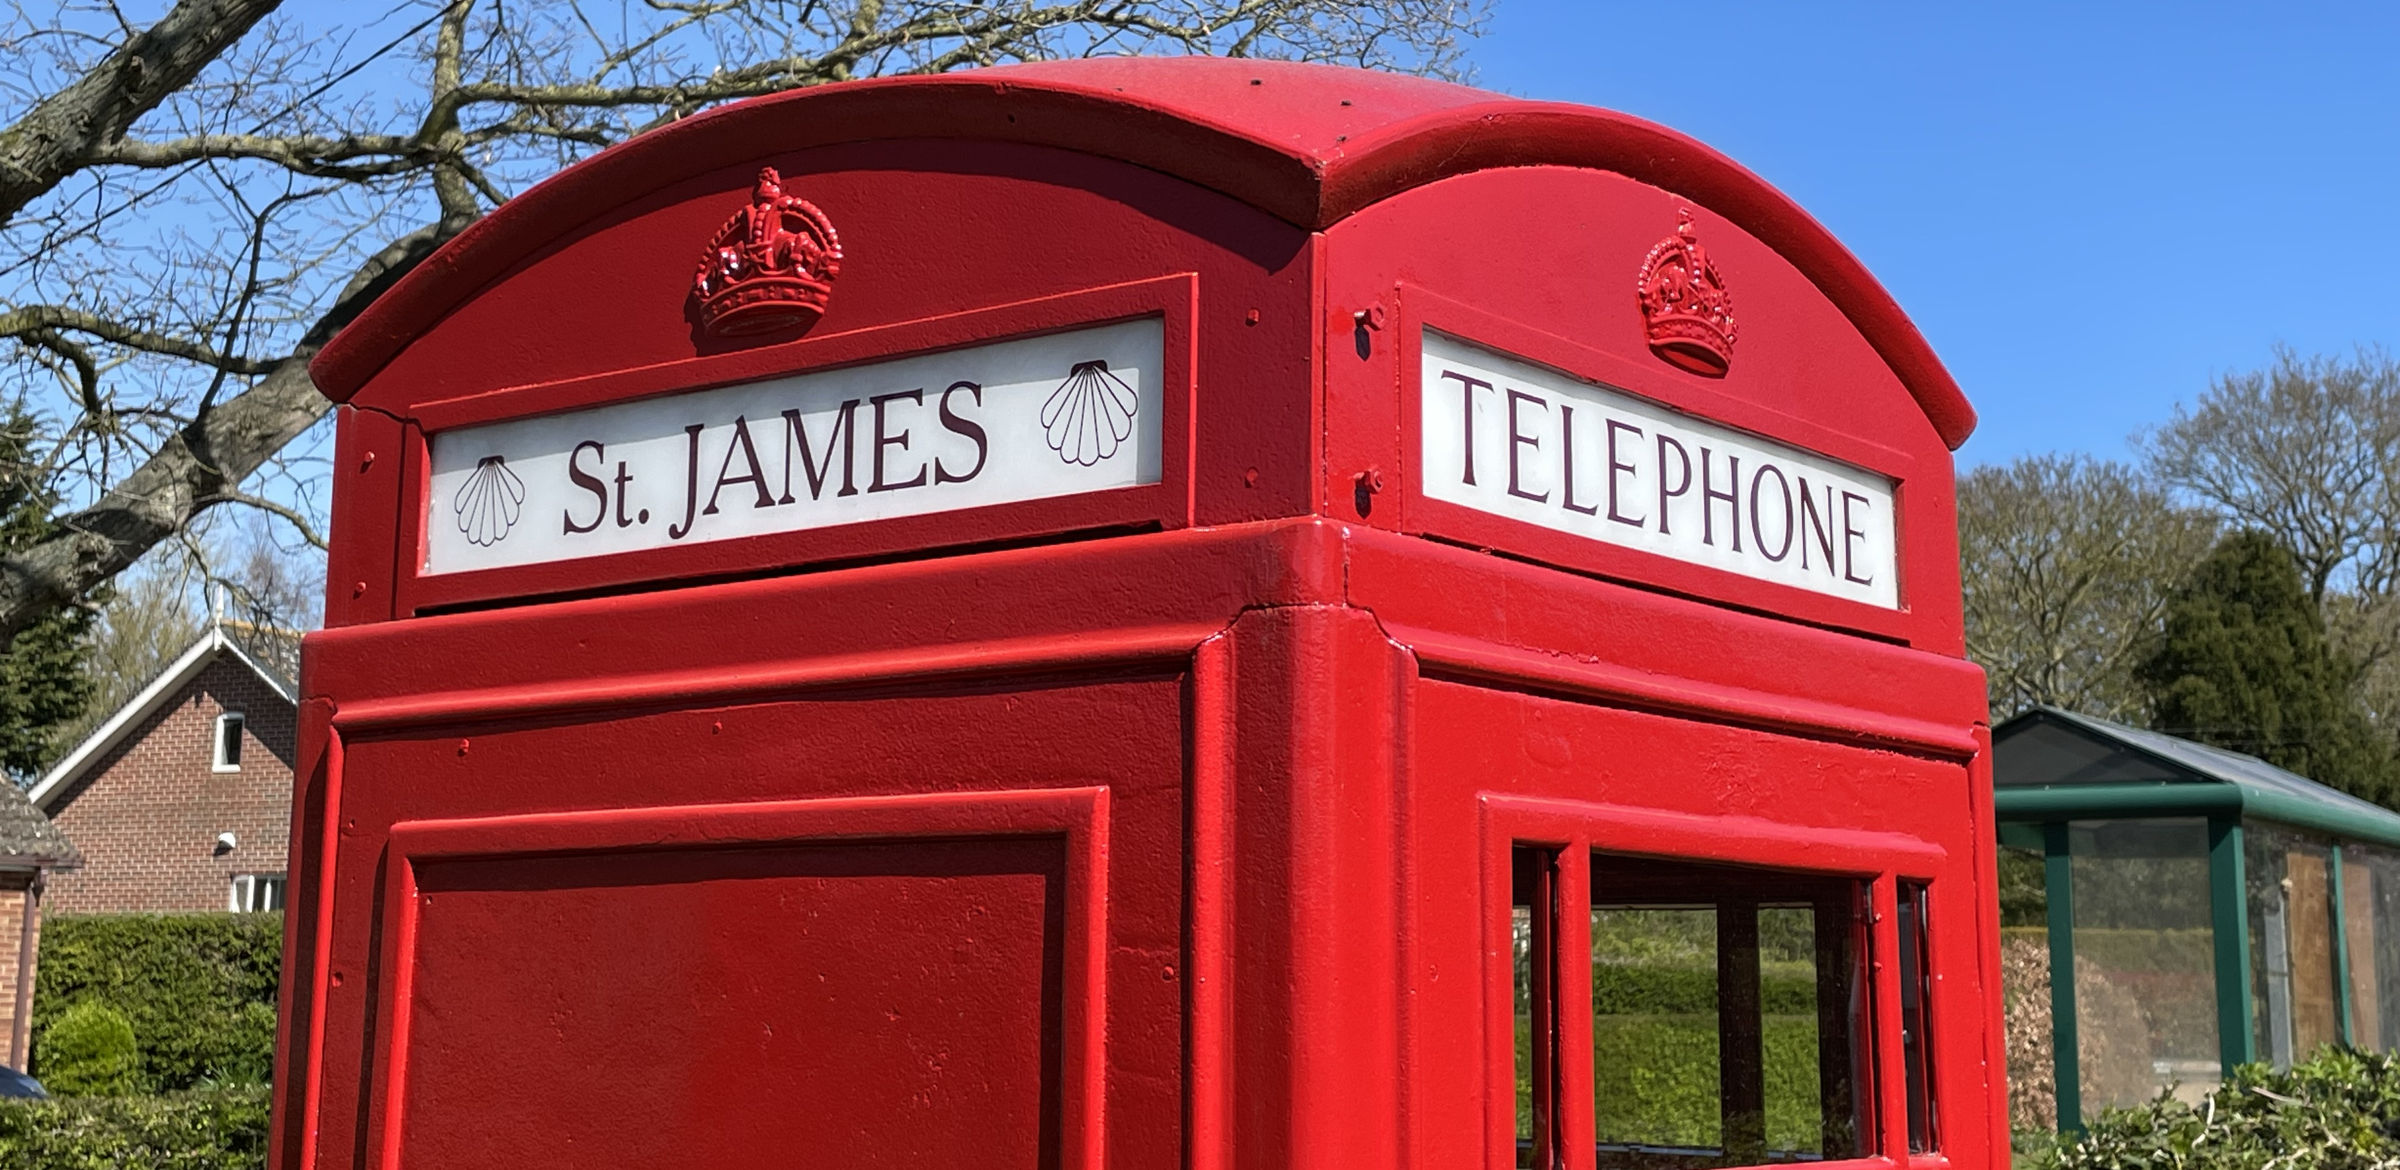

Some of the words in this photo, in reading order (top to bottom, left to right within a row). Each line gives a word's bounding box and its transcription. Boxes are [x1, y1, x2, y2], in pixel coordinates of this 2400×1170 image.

[563, 440, 649, 536] St.
[669, 381, 989, 540] JAMES
[1441, 369, 1874, 586] TELEPHONE
